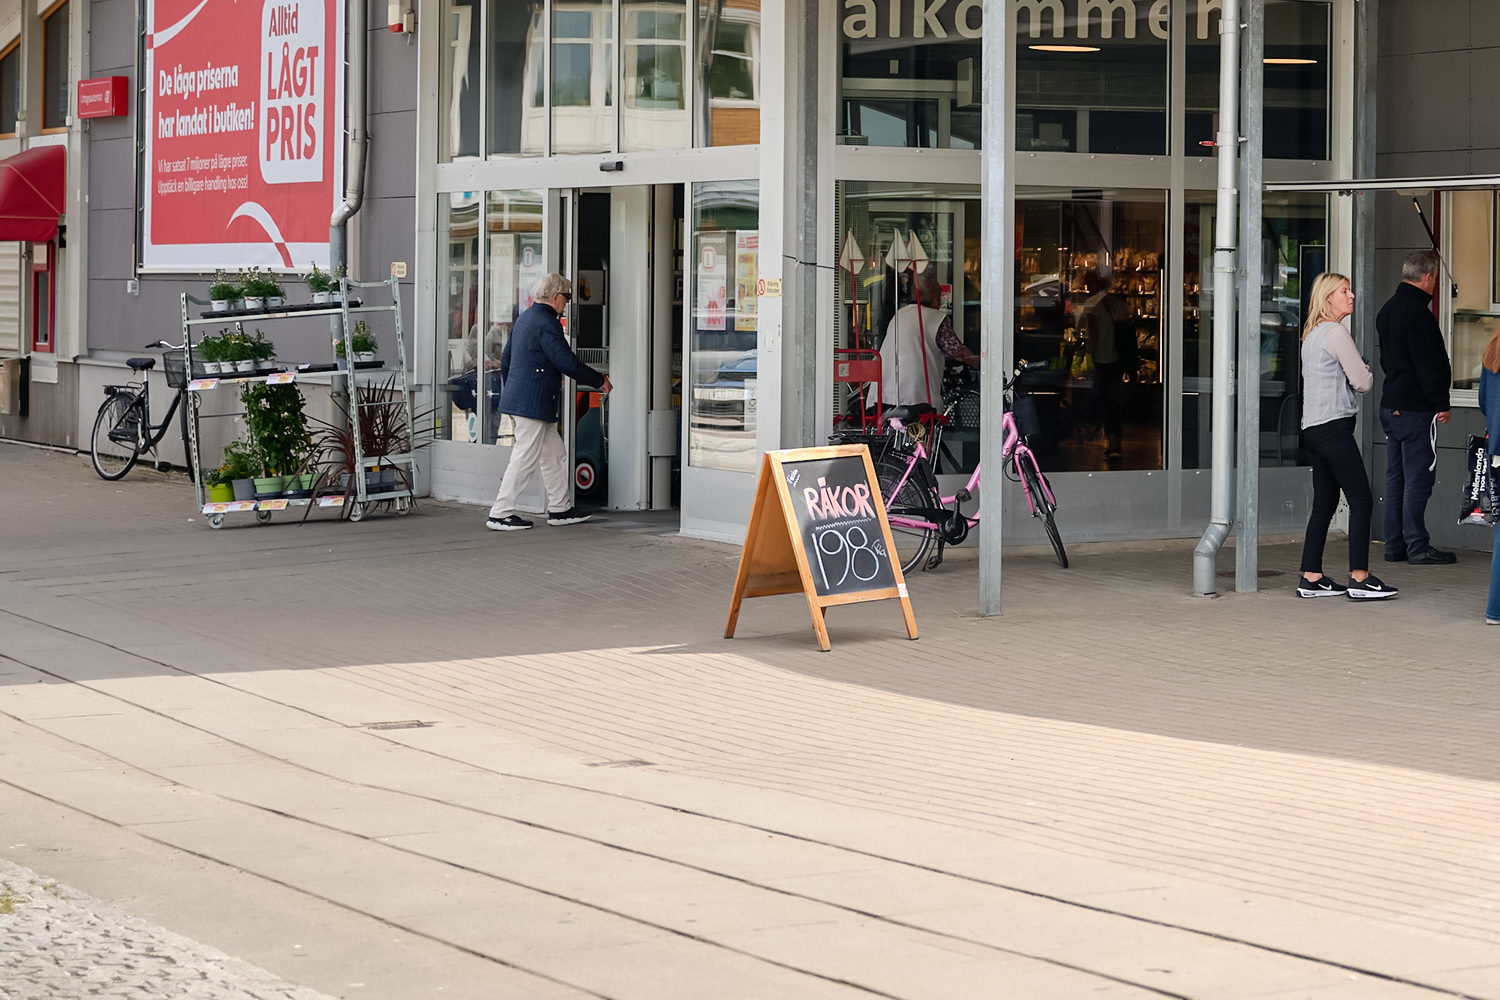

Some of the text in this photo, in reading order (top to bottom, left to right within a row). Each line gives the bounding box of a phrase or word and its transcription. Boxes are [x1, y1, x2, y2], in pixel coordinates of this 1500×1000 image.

[268, 3, 299, 37] Alltid
[159, 61, 239, 100] De låga priserna
[267, 41, 319, 100] LÅGT
[158, 101, 255, 139] har landat i butiken!
[266, 102, 316, 162] PRIS
[157, 159, 163, 173] Vi
[163, 158, 172, 173] har
[171, 158, 187, 173] satsat
[186, 156, 190, 171] 7
[190, 156, 211, 173] miljoner
[210, 153, 218, 172] på
[218, 153, 232, 172] lägre
[157, 178, 178, 196] Upptäck
[177, 180, 184, 193] en
[184, 177, 205, 195] billigare
[204, 175, 227, 193] handling
[227, 174, 237, 190] hos
[1470, 447, 1484, 501] Mellanlanda
[811, 526, 880, 590] 198
